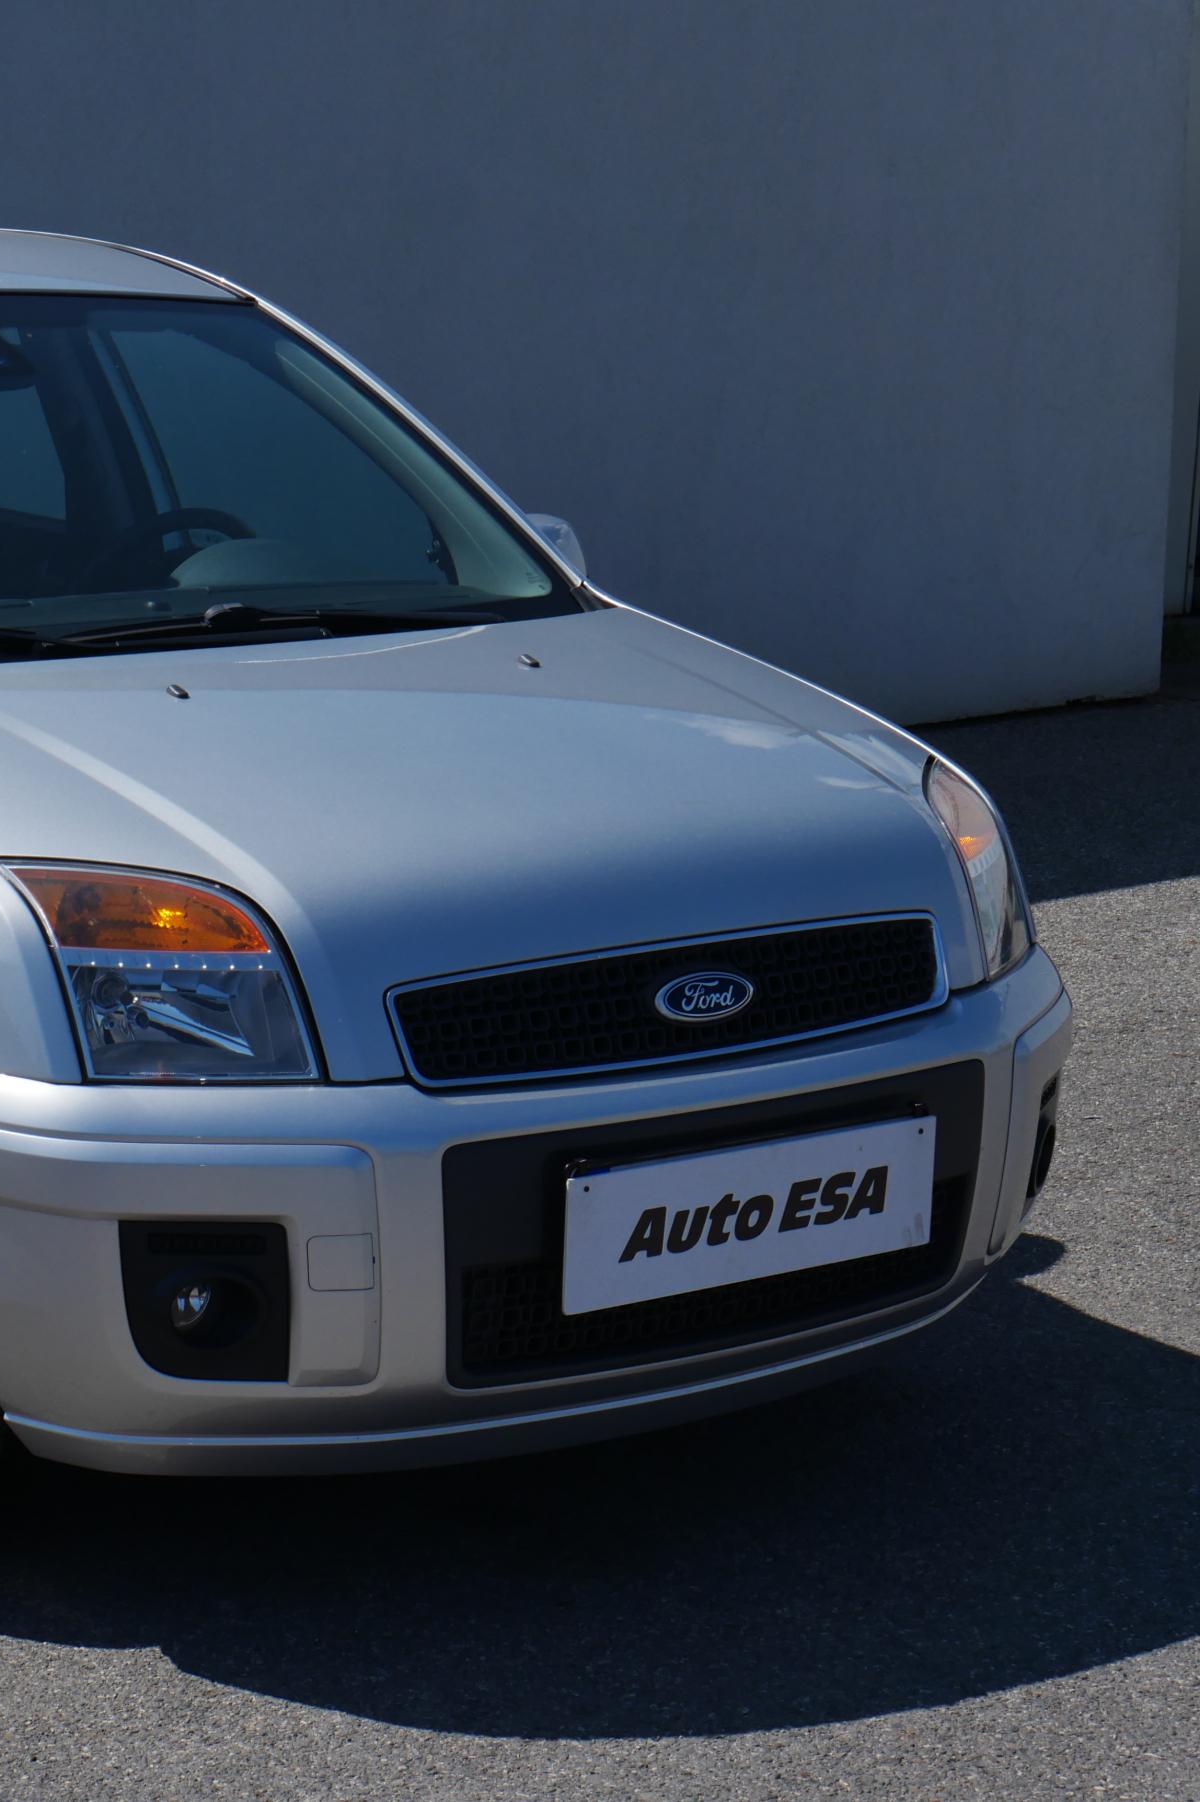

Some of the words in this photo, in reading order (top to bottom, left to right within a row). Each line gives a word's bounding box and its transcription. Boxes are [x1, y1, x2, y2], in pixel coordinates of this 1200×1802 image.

[681, 980, 735, 1012] Ford
[618, 1193, 774, 1264] Auto
[777, 1165, 889, 1233] ESA
